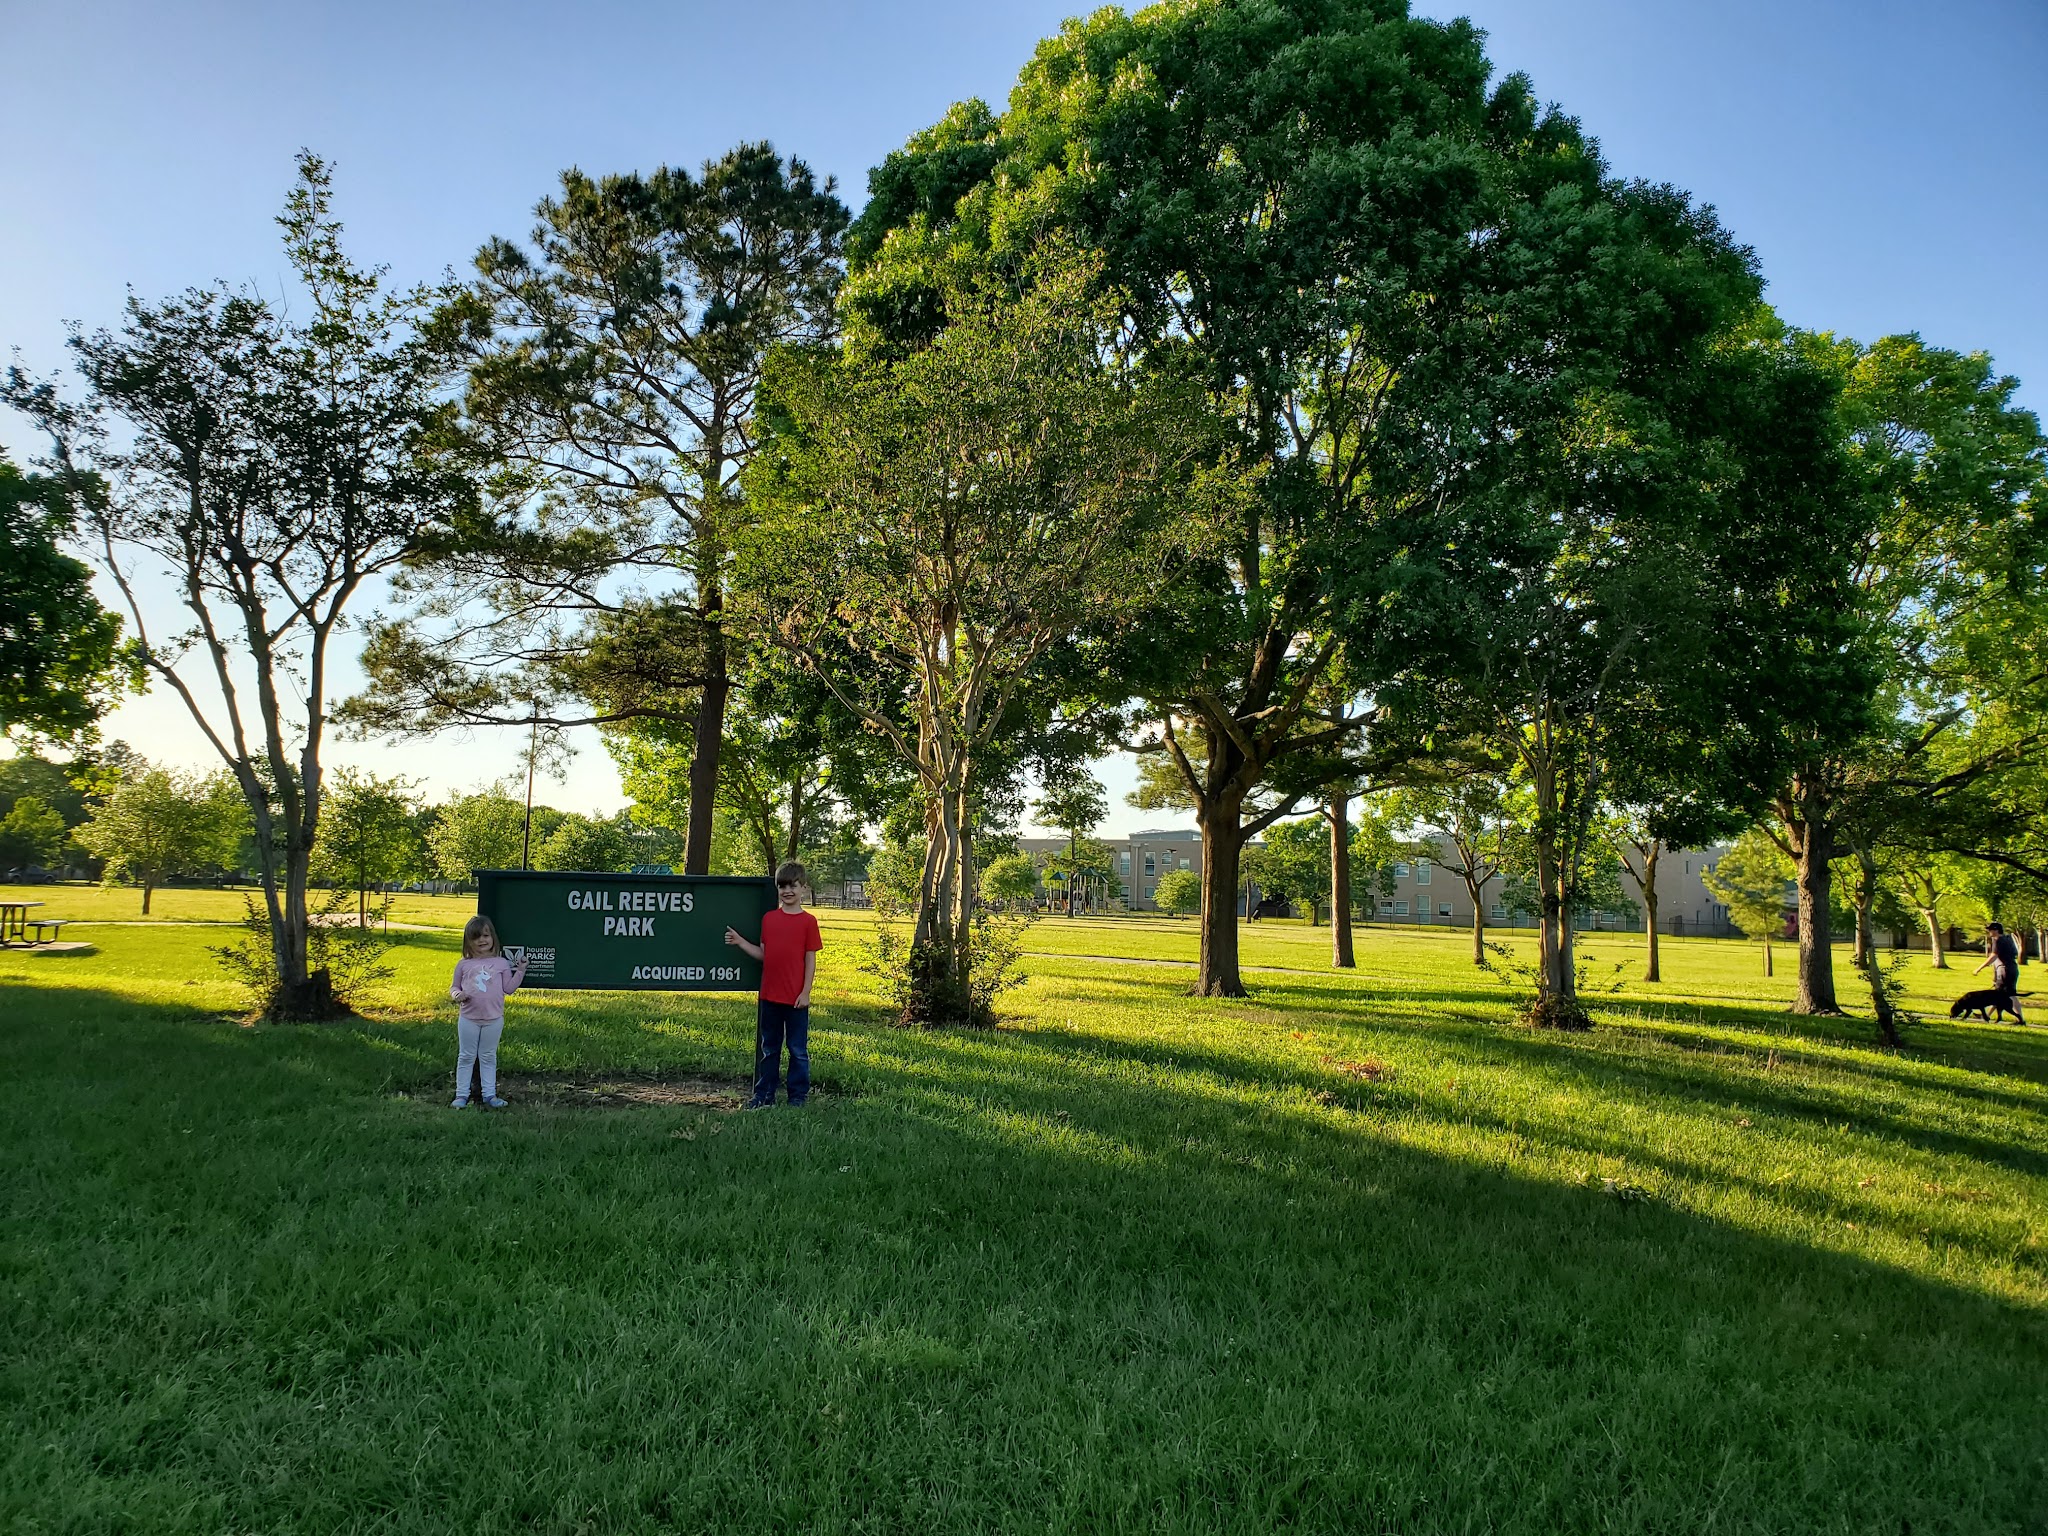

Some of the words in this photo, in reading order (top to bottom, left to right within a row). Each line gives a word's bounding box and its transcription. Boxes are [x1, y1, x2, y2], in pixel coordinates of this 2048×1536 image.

[567, 890, 614, 911] GAIL
[618, 891, 694, 912] REEVES
[603, 916, 655, 937] PARK
[631, 965, 705, 981] ACQUIRED
[709, 966, 741, 981] 1961
